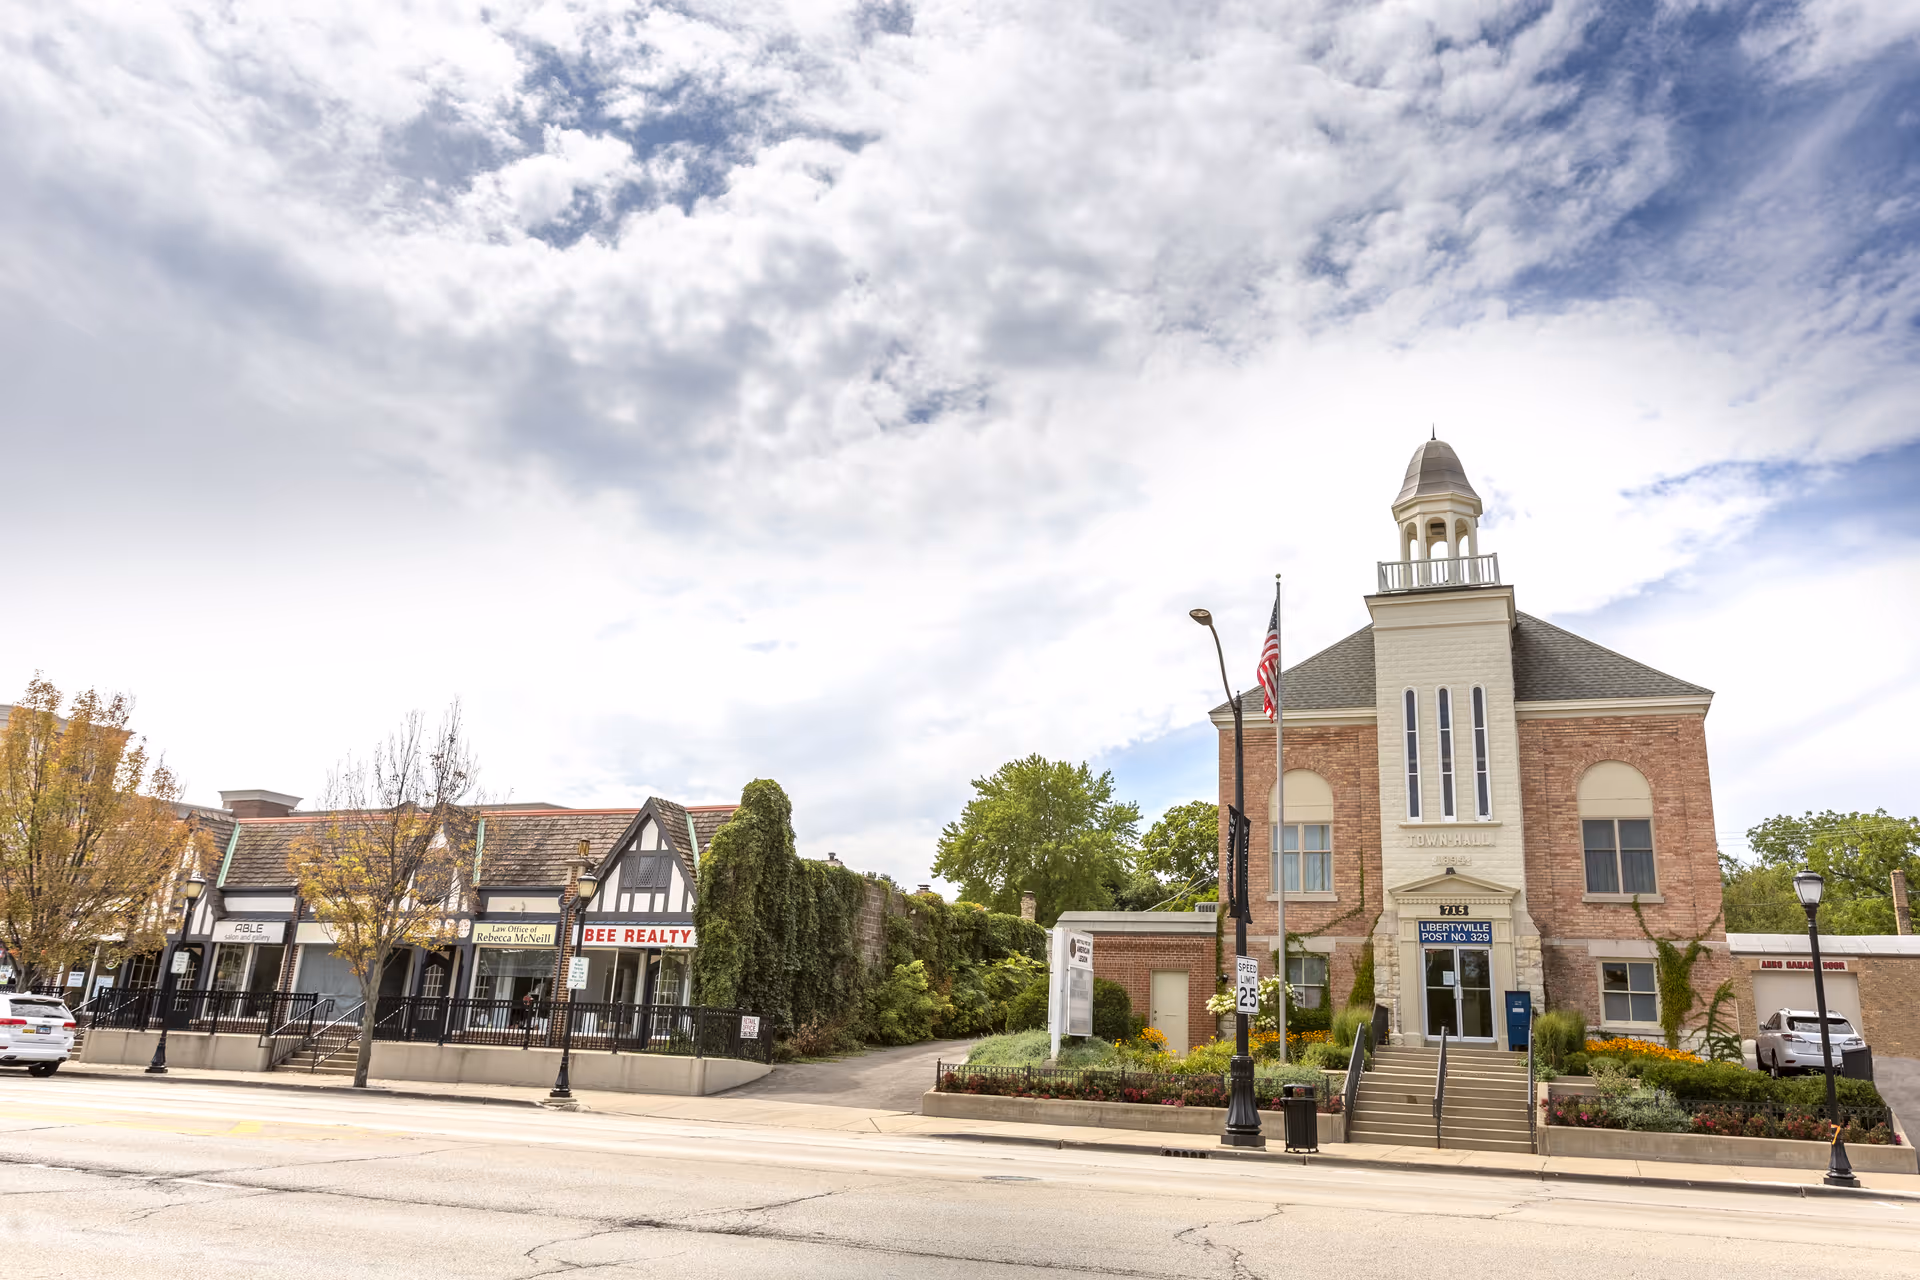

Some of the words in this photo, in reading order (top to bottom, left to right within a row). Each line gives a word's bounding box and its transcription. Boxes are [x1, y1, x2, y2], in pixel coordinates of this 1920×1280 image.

[1443, 906, 1465, 915] 715
[234, 923, 264, 933] ABLE
[492, 925, 506, 933] Law
[507, 925, 529, 934] Office
[530, 926, 538, 934] of
[1420, 923, 1490, 932] LIBERTYVILLE
[252, 934, 270, 942] gallery
[476, 932, 512, 943] Rebecca
[513, 933, 551, 944] McNeill
[584, 928, 617, 942] BEE
[624, 929, 692, 944] REALTY
[1422, 932, 1448, 941] POST
[1451, 932, 1468, 941] NO.
[1470, 933, 1490, 942] 329
[1238, 963, 1257, 973] SPEED
[1786, 961, 1814, 969] GARAG
[1822, 962, 1845, 970] DOOR
[1240, 975, 1255, 985] LIMIT
[1239, 986, 1256, 1008] 25
